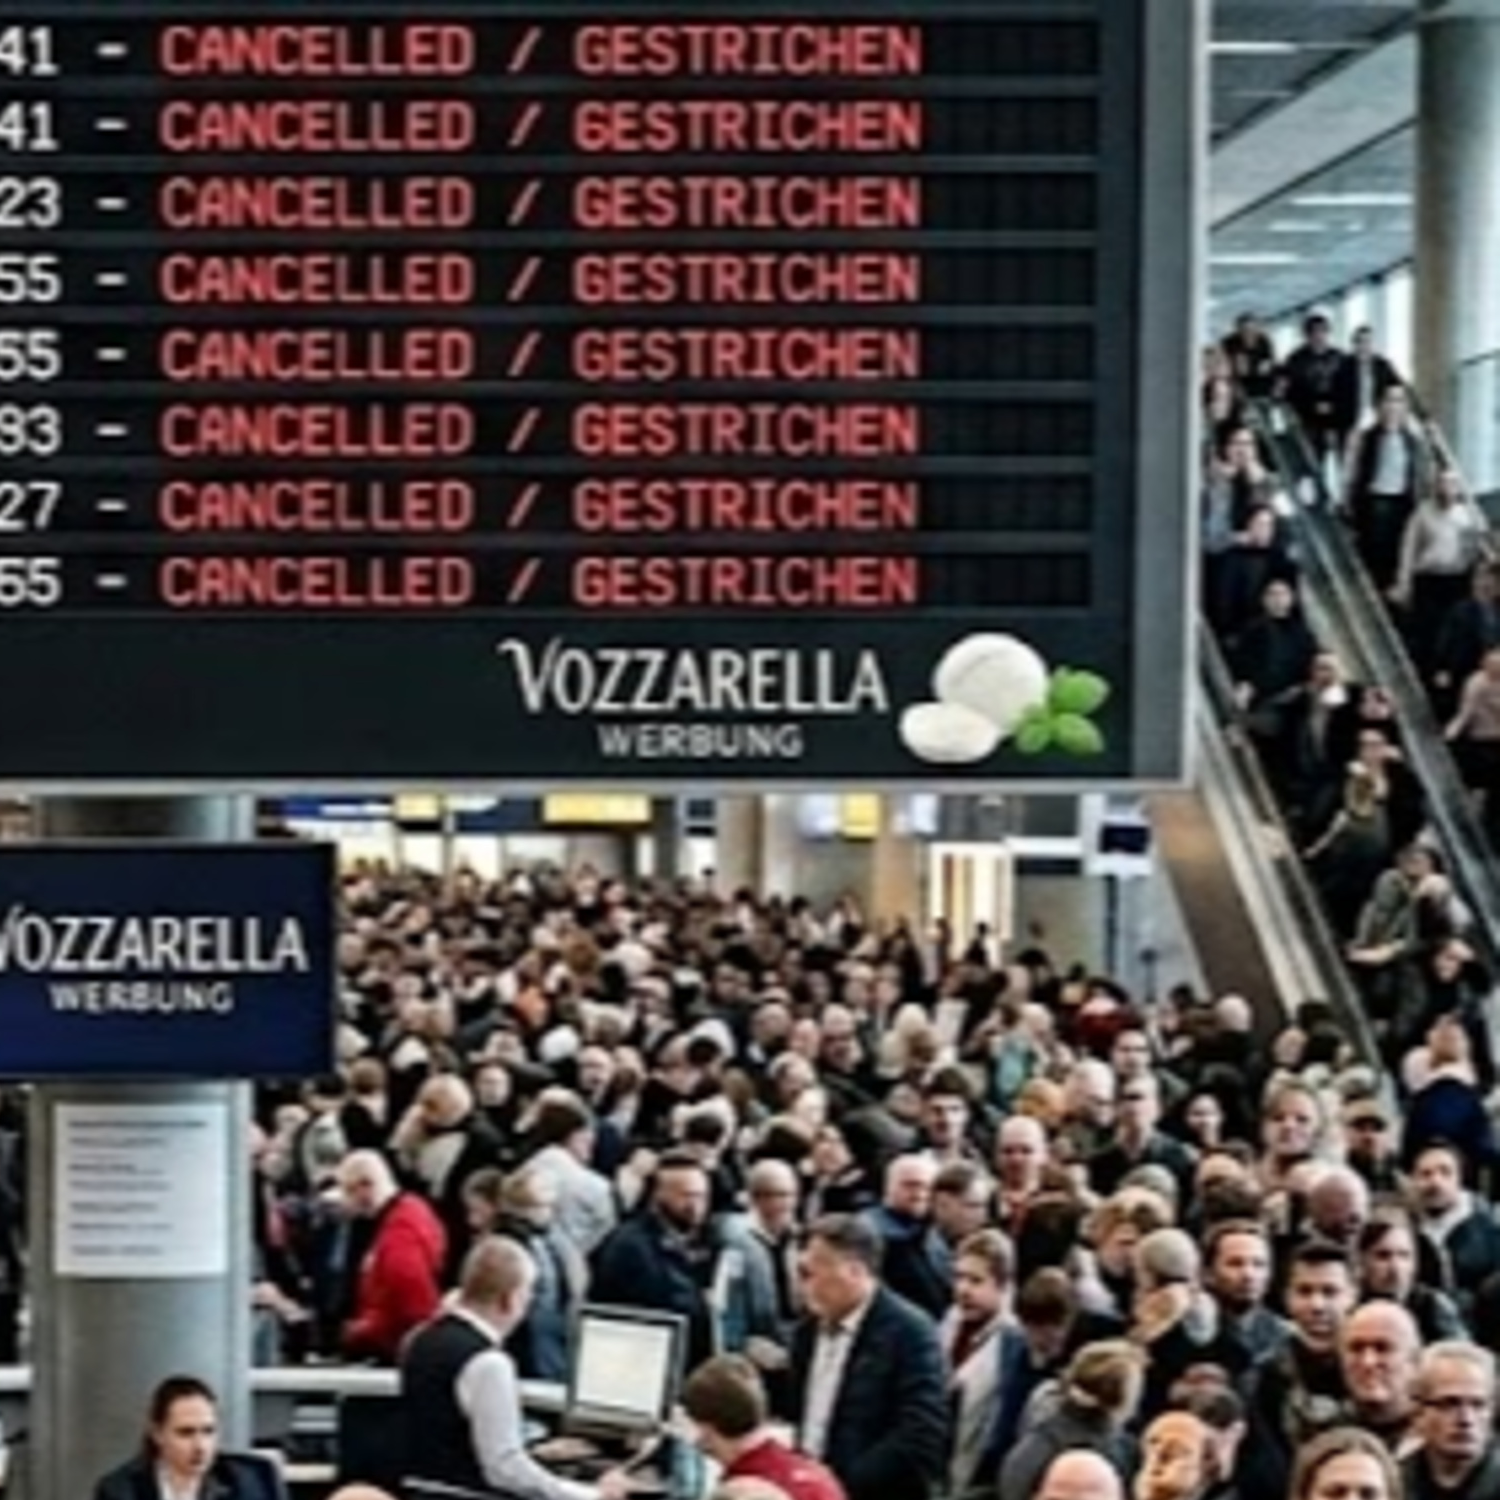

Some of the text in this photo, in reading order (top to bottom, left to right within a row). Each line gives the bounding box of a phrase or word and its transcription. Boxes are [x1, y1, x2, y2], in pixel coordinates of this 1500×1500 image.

[160, 25, 472, 75] CANCELLED
[509, 29, 540, 71] /
[573, 25, 921, 75] GESTRICHEN
[160, 101, 472, 151] CANCELLED
[509, 104, 540, 146] /
[573, 101, 921, 151] GESTRICHEN
[160, 176, 472, 228] CANCELLED
[509, 182, 540, 222] /
[573, 176, 920, 228] GESTRICHEN
[160, 254, 472, 304] CANCELLED
[509, 258, 540, 300] /
[573, 254, 918, 304] GESTRICHEN
[160, 330, 472, 381] CANCELLED
[509, 333, 540, 376] /
[573, 330, 918, 381] GESTRICHEN
[160, 405, 472, 456] CANCELLED
[509, 410, 540, 450] /
[573, 405, 918, 456] GESTRICHEN
[160, 481, 472, 531] CANCELLED
[509, 486, 540, 525] /
[573, 481, 916, 531] GESTRICHEN
[160, 556, 472, 606] CANCELLED
[509, 561, 540, 600] /
[573, 556, 916, 606] GESTRICHEN
[498, 636, 889, 713] VOZZARELLA
[599, 723, 804, 758] WERBUNG
[48, 981, 235, 1013] WERBUNG
